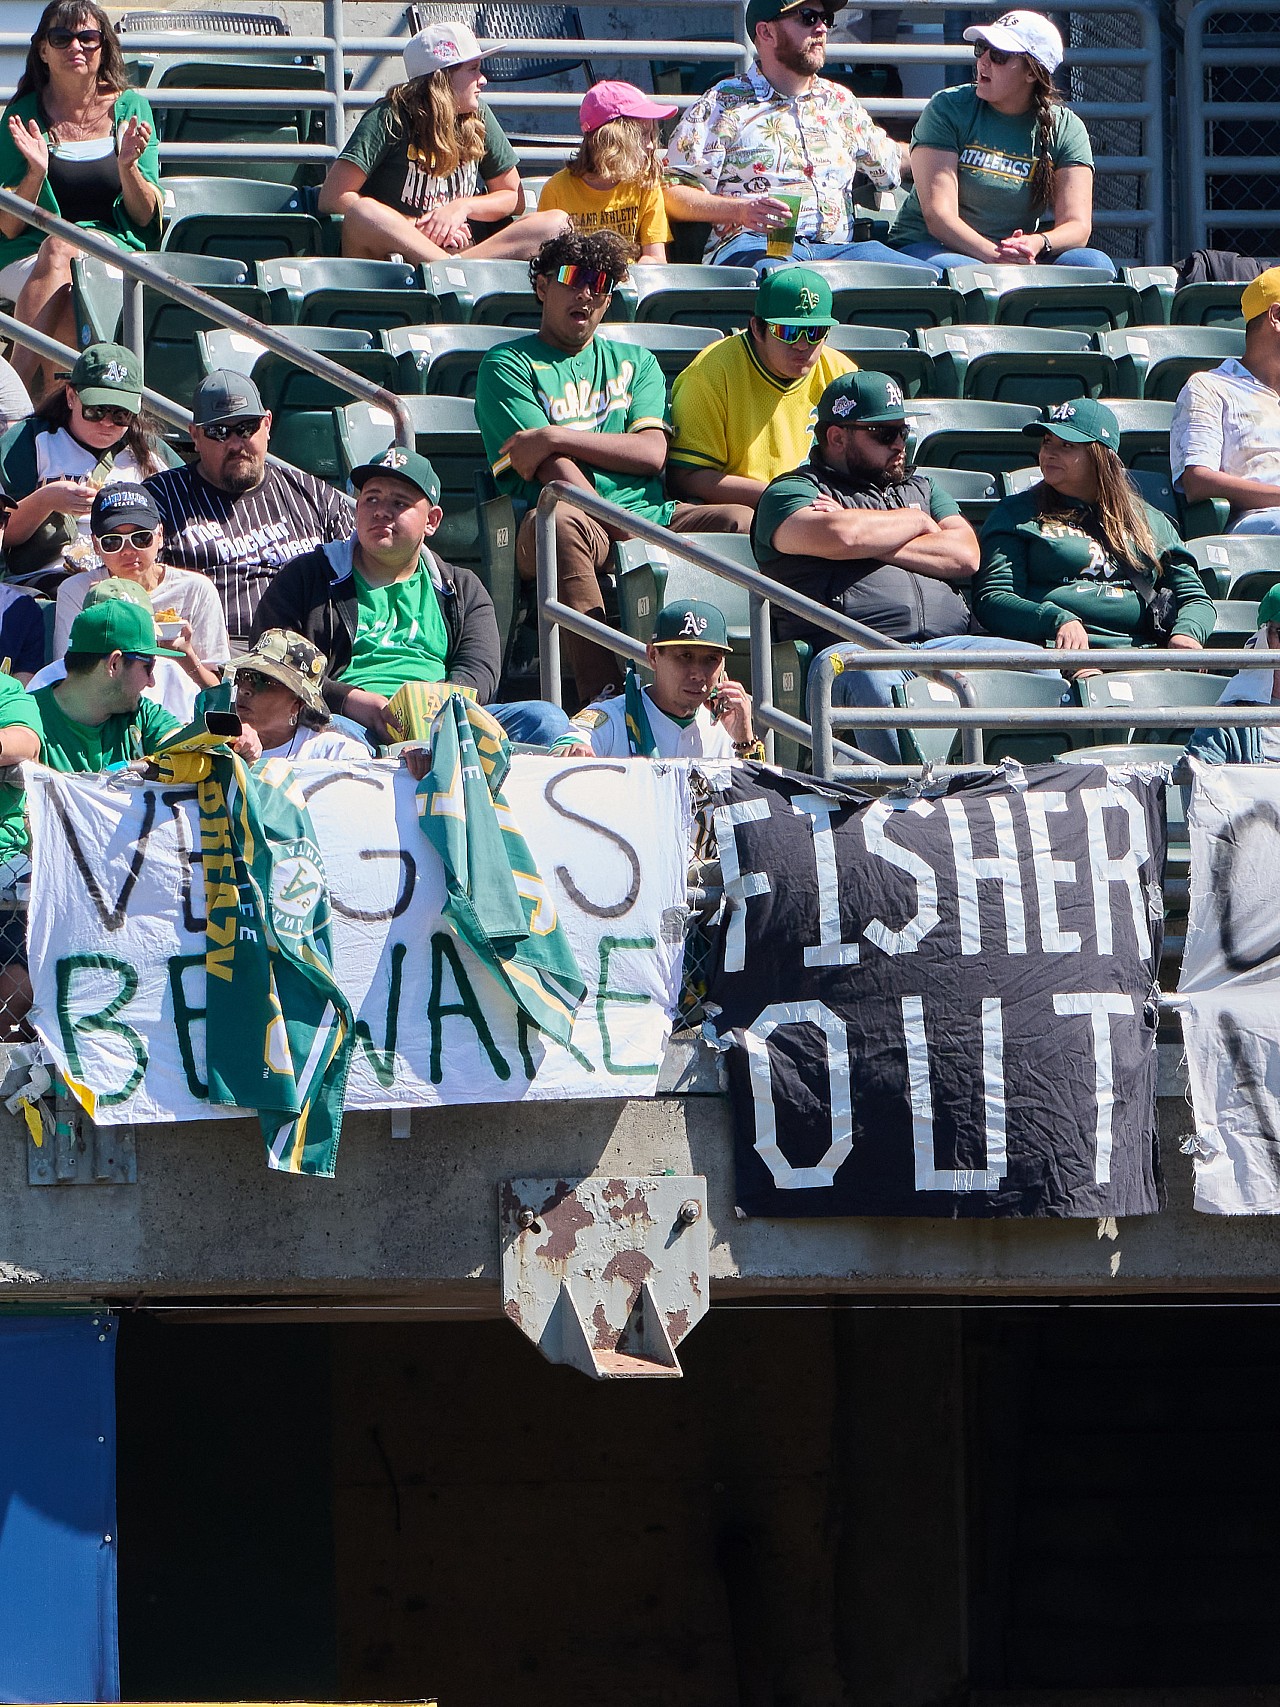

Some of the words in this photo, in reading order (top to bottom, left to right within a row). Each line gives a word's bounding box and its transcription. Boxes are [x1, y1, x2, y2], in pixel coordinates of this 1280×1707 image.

[959, 149, 1031, 177] ATHLETICS
[600, 206, 640, 225] ATHLETIC
[102, 360, 128, 383] A's
[538, 360, 633, 422] akland
[1051, 404, 1077, 420] A's
[379, 448, 408, 469] A's
[182, 521, 224, 547] The
[262, 536, 322, 567] Shee
[678, 611, 708, 636] A's
[44, 763, 642, 932] VEGS
[714, 787, 1152, 973] FISHER
[745, 993, 1136, 1191] OUT
